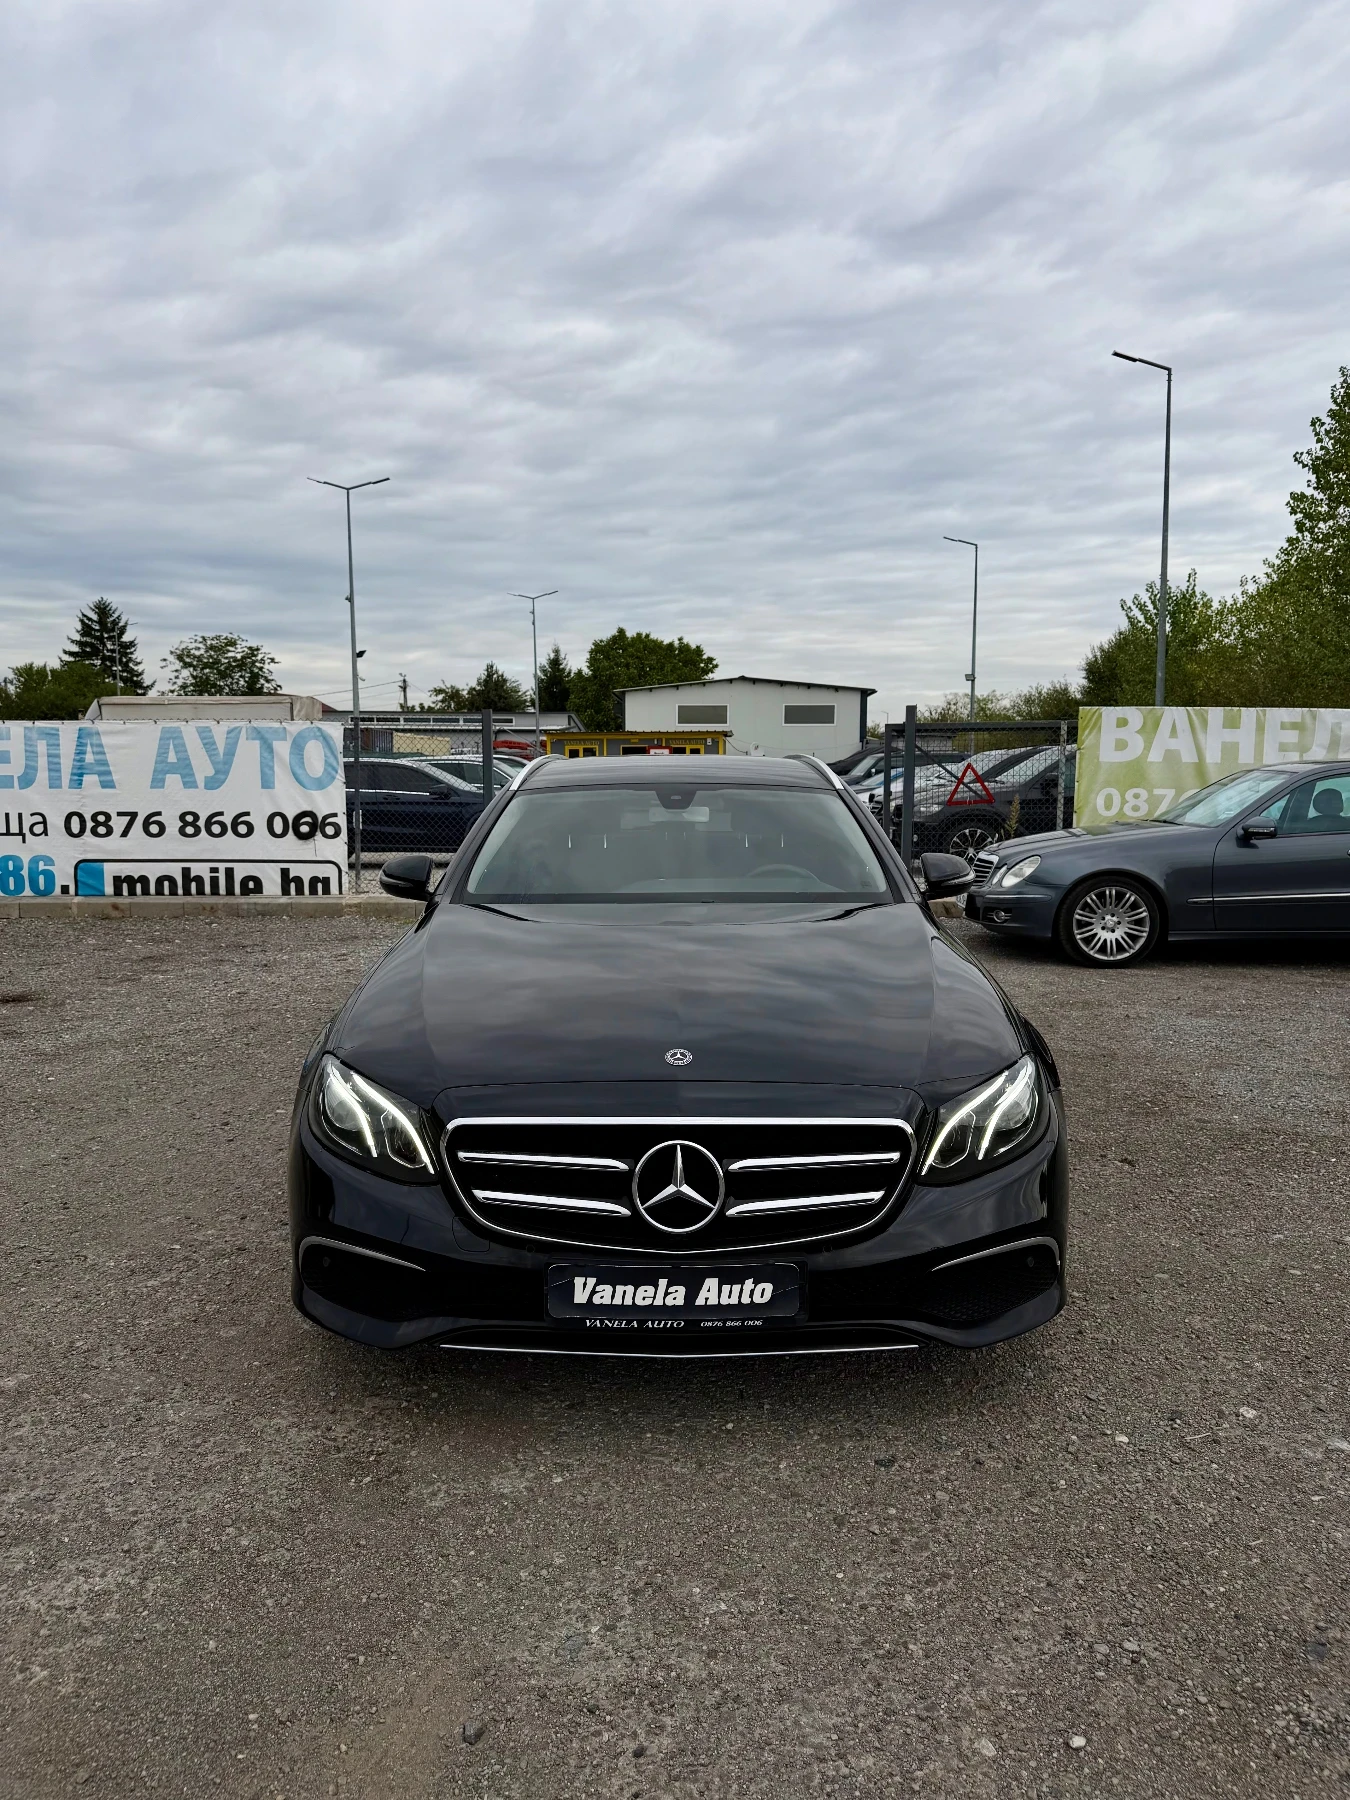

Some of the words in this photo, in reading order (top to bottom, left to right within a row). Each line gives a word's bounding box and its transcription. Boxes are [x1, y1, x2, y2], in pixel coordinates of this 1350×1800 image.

[150, 726, 340, 791] АУТО
[1096, 787, 1201, 818] 087
[64, 811, 166, 838] 0876
[178, 811, 255, 838] 866
[573, 1277, 686, 1306] Vanela
[695, 1278, 773, 1306] Auto
[585, 1319, 638, 1328] VANELA
[643, 1320, 685, 1328] AUTO
